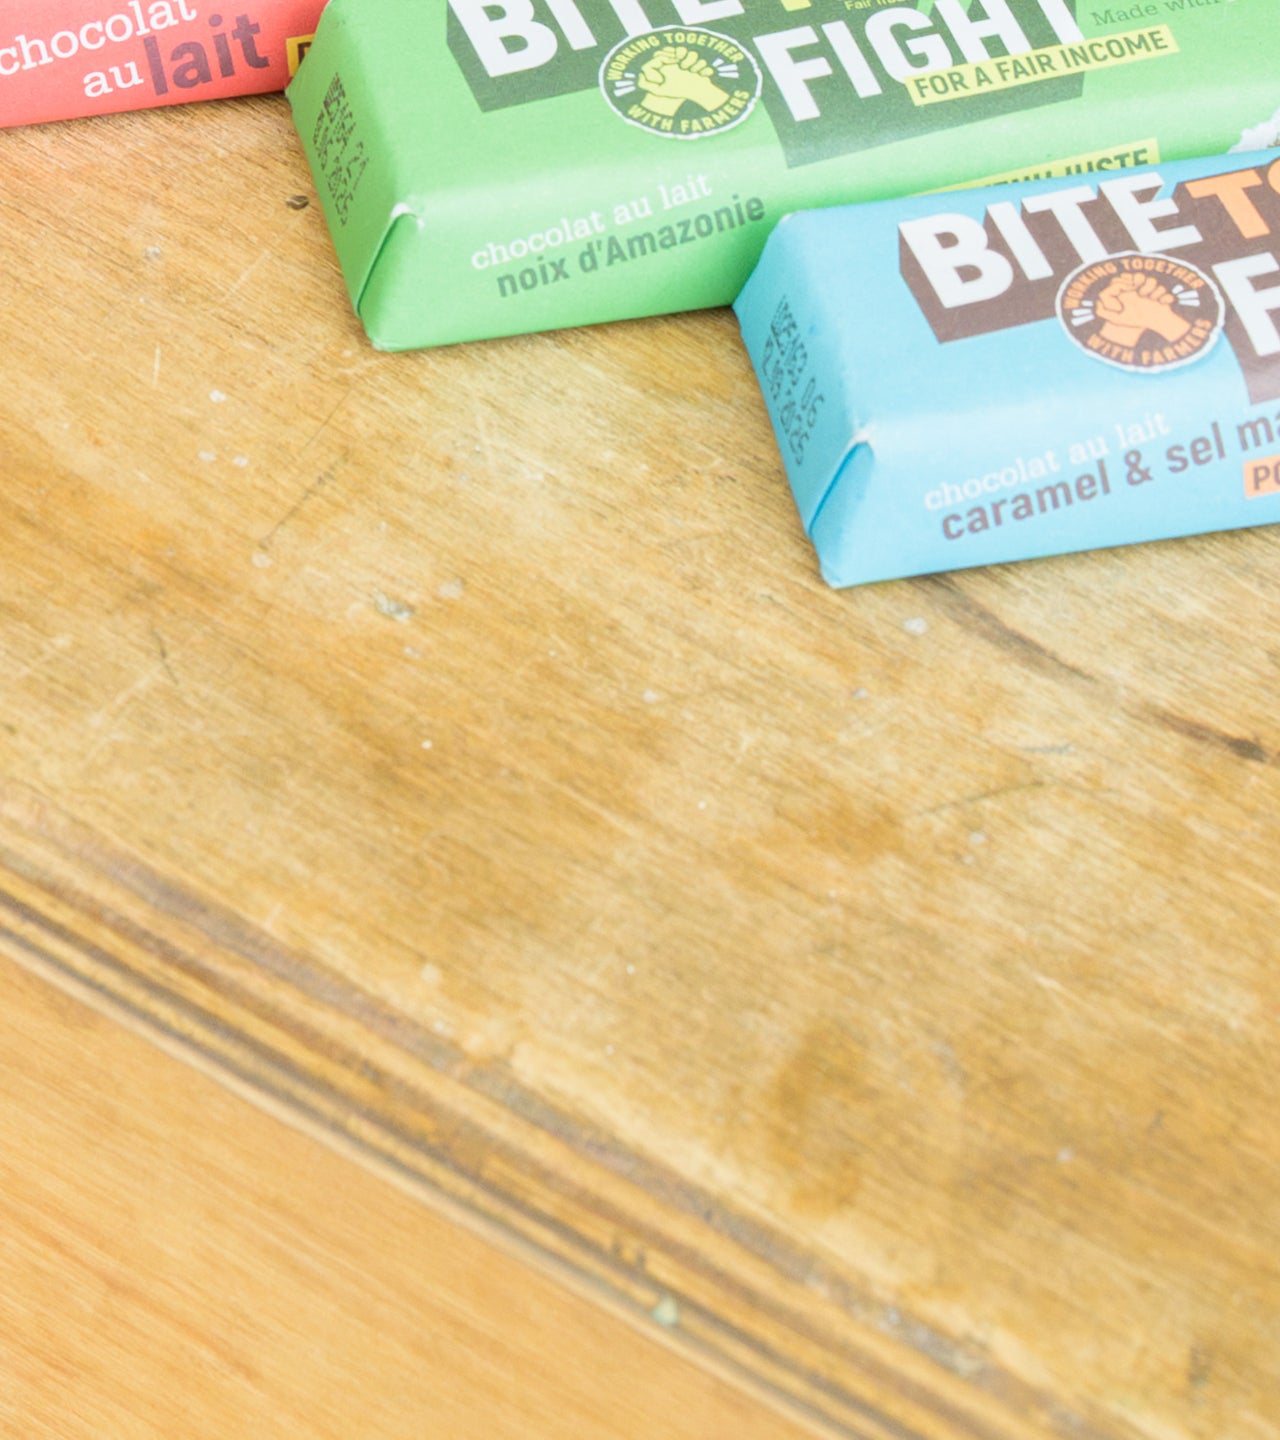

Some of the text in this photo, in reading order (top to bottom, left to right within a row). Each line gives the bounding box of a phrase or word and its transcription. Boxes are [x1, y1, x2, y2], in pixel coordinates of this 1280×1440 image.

[82, 61, 144, 98] au
[143, 14, 269, 96] lait
[604, 30, 744, 80] WORKING TOGETHER
[1090, 1, 1159, 26] Made
[913, 30, 1169, 99] FOR A FAIR INCOME
[627, 89, 750, 133] WITH FARMERS
[470, 172, 712, 271] chocolat au lait
[496, 191, 766, 298] noix d'Amazonie
[899, 171, 1204, 309] BITE
[924, 410, 1170, 511] chocolat au lait
[941, 460, 1112, 540] caramel
[1125, 451, 1153, 485] &
[1166, 422, 1225, 477] sel
